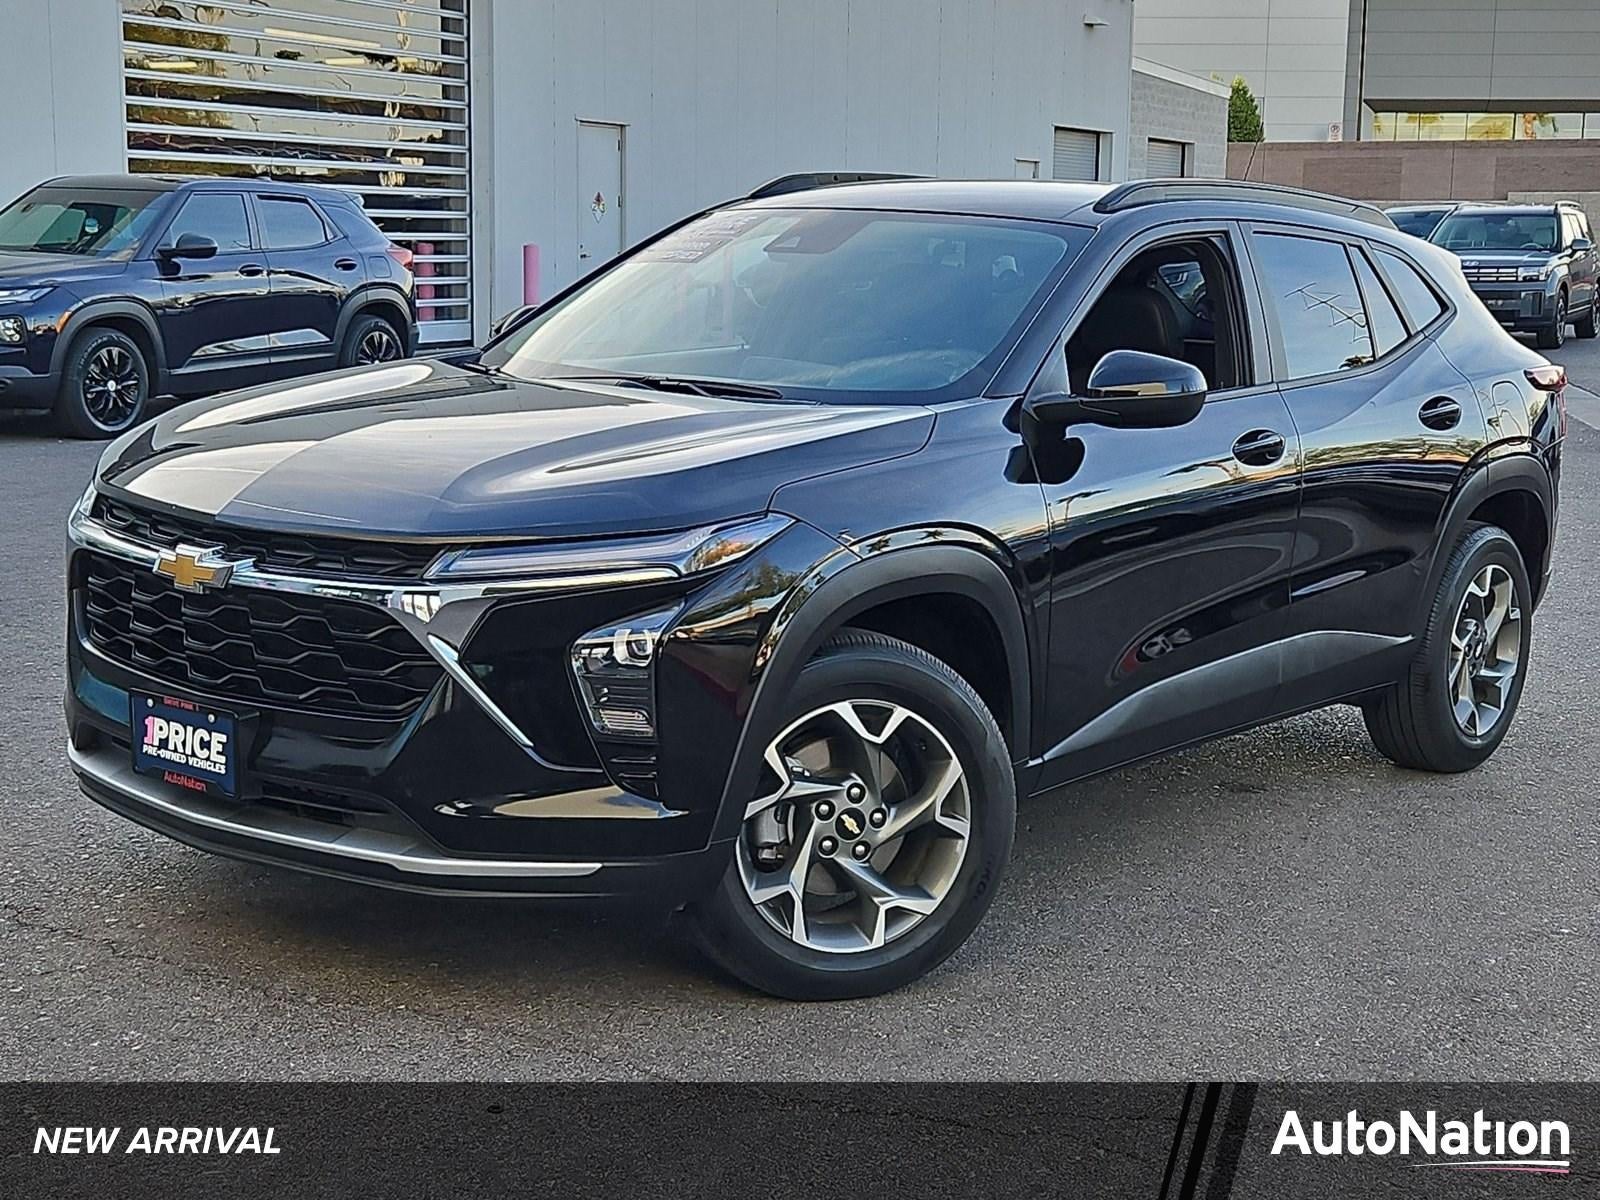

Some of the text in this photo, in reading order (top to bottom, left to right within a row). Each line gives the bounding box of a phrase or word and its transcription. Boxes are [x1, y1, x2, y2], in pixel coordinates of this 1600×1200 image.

[142, 744, 226, 775] PRE-OWNED VEHICLES
[163, 770, 207, 792] AutoNation
